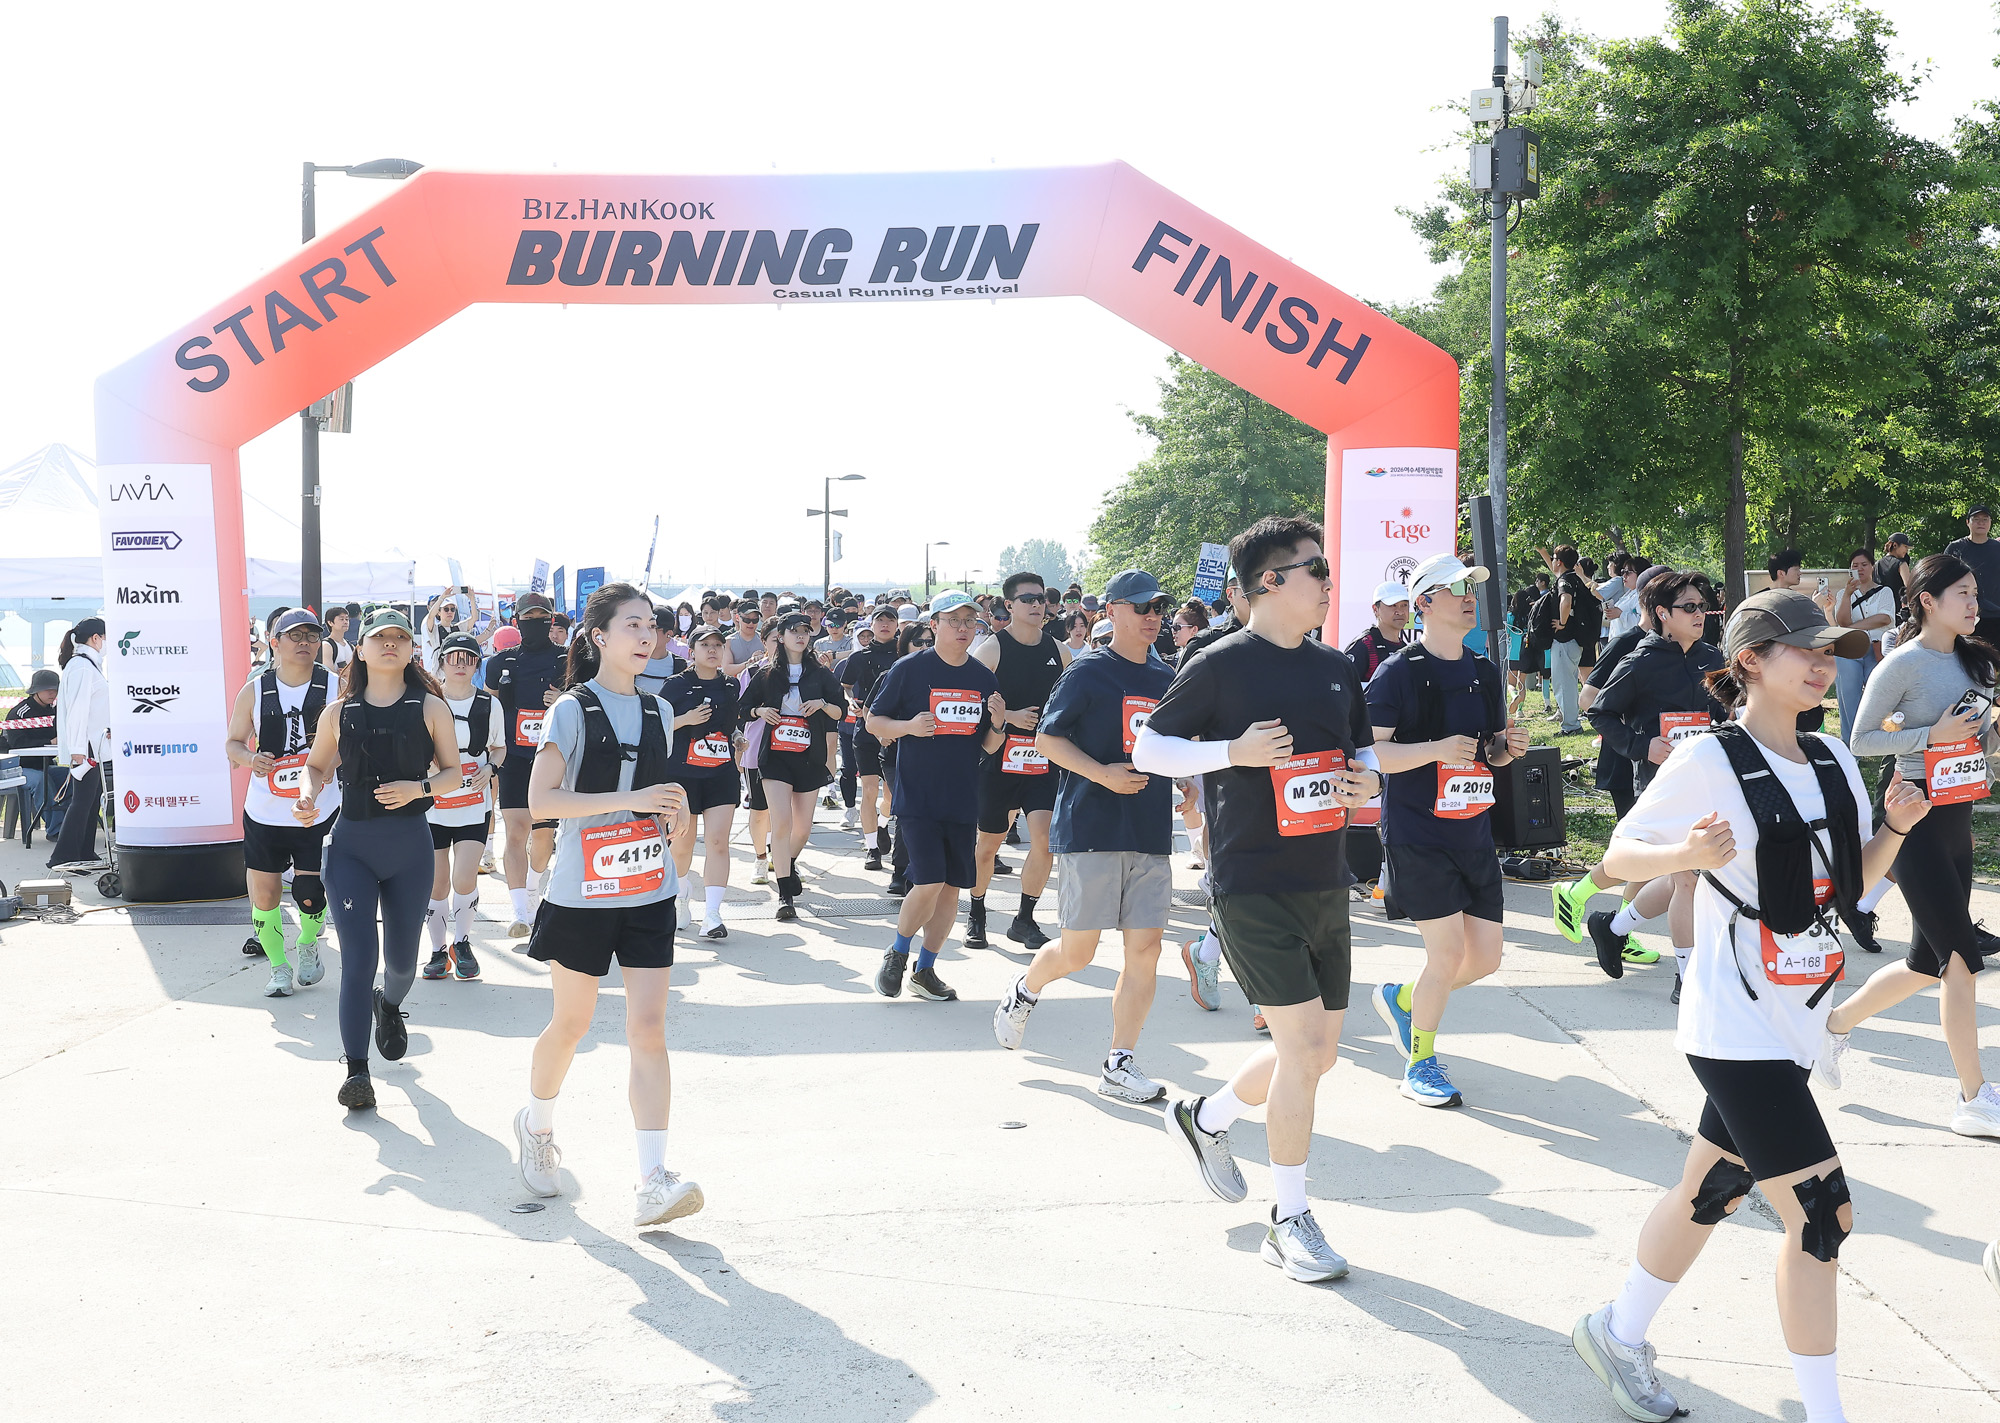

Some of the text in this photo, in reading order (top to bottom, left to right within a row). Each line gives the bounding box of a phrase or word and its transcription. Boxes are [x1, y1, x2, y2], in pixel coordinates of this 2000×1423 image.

[506, 223, 1040, 286] BURNING RUN
[773, 283, 1019, 299] Casual Running Festival
[175, 225, 397, 393] START
[1131, 220, 1372, 385] FINISH
[1380, 520, 1430, 544] Tage
[115, 535, 169, 548] FAVONEX
[1199, 558, 1227, 576] 정근식
[1195, 576, 1222, 591] 민주진보
[116, 583, 180, 604] Maxim
[127, 685, 181, 698] Reebok
[940, 705, 980, 716] M 1844
[786, 728, 810, 739] 3530
[1673, 732, 1681, 740] M
[1305, 757, 1320, 766] RUN
[1940, 757, 1985, 776] W 3532
[279, 774, 287, 782] M
[1937, 777, 1956, 786] C-33
[1293, 786, 1305, 799] M
[1450, 781, 1492, 794] M 2019
[144, 795, 201, 808] 롯데웰푸드
[585, 829, 618, 840] BURNING
[618, 827, 632, 835] RUN
[601, 843, 662, 866] W 4119
[586, 882, 616, 892] B-165
[1814, 886, 1830, 895] RUN
[1784, 957, 1821, 968] A-168
